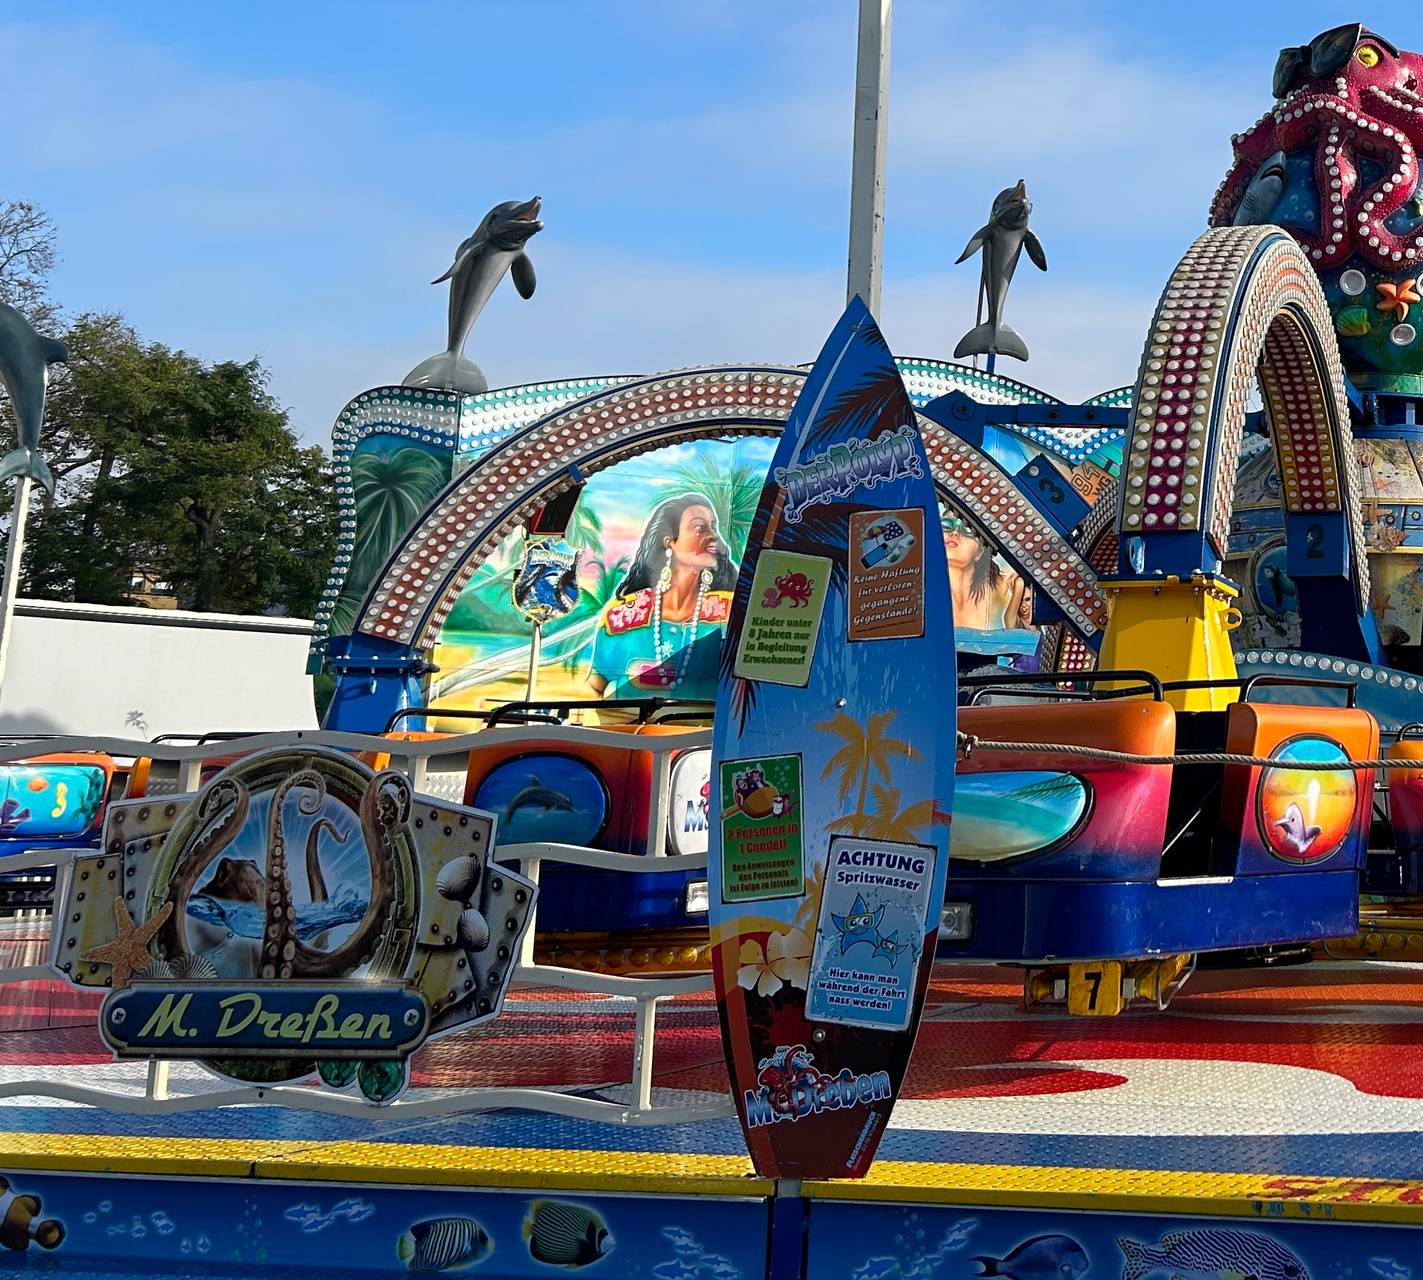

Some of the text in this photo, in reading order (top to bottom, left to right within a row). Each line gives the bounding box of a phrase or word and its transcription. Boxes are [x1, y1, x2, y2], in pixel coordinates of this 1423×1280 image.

[1071, 461, 1100, 496] 94
[1039, 478, 1065, 505] 3
[1306, 523, 1325, 559] 2
[853, 566, 920, 584] Keine Haftung
[858, 582, 912, 598] für verloren
[860, 595, 910, 611] gegangene
[752, 616, 813, 627] Kinder unter
[853, 606, 918, 626] Gegenstände!
[748, 628, 811, 640] 8 Jahren nur
[745, 641, 807, 654] in Begleitung
[742, 653, 806, 665] Erwachsener!
[727, 823, 798, 840] 2 Personen in
[739, 844, 745, 854] 1
[747, 859, 795, 871] Anweisungen
[837, 850, 926, 874] ACHTUNG
[739, 869, 789, 881] des Personals
[837, 871, 920, 891] Spritzwasser
[741, 881, 760, 892] Folge
[829, 968, 899, 985] Hier kann man
[818, 980, 906, 999] während der Fahrt
[1085, 971, 1103, 1011] 7
[828, 995, 892, 1010] nass werden!
[136, 992, 394, 1044] M. Dreßen
